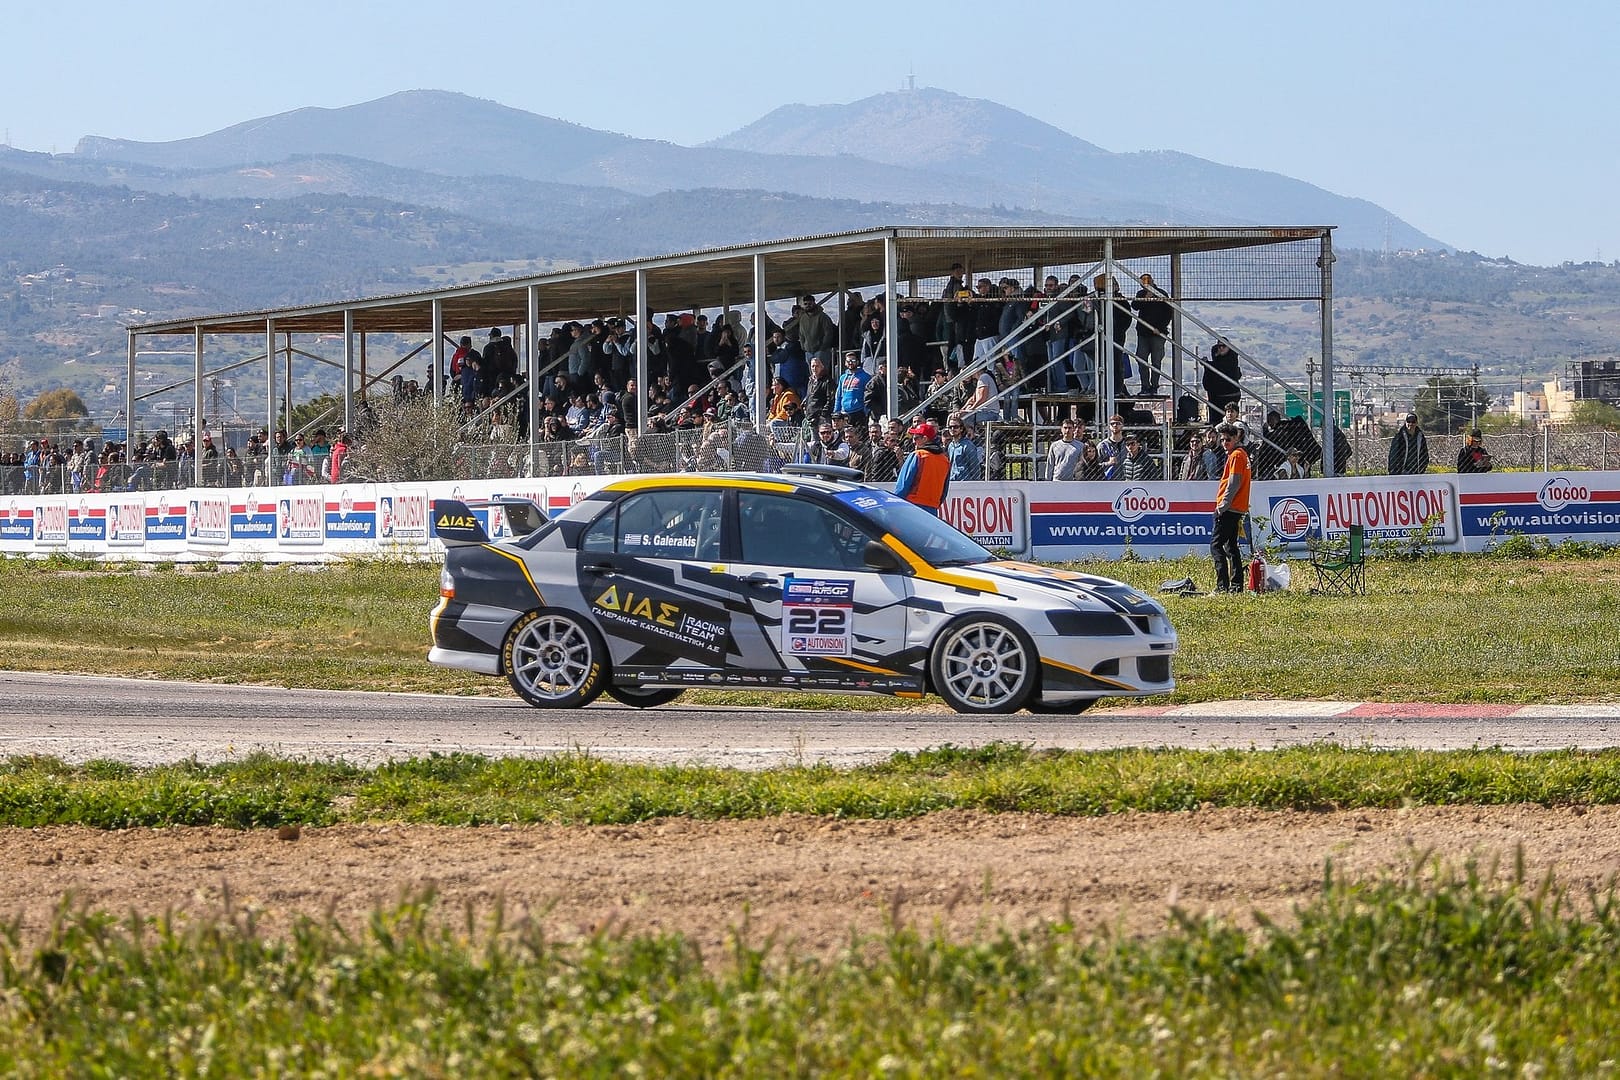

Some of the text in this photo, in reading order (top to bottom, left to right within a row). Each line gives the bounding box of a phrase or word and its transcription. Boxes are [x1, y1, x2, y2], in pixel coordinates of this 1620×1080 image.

[1548, 487, 1588, 500] 10600
[1124, 497, 1166, 511] 10600
[1326, 490, 1445, 528] AUTOVISION
[437, 514, 476, 527] ΔΙΑΣ
[939, 497, 1012, 533] VISION
[643, 534, 696, 547] S. Galerakis
[594, 584, 680, 627] ΔΙΑΣ
[687, 616, 726, 636] RACING
[789, 609, 845, 634] 22
[685, 625, 715, 641] TEAM
[808, 638, 844, 649] AUTOVISION
